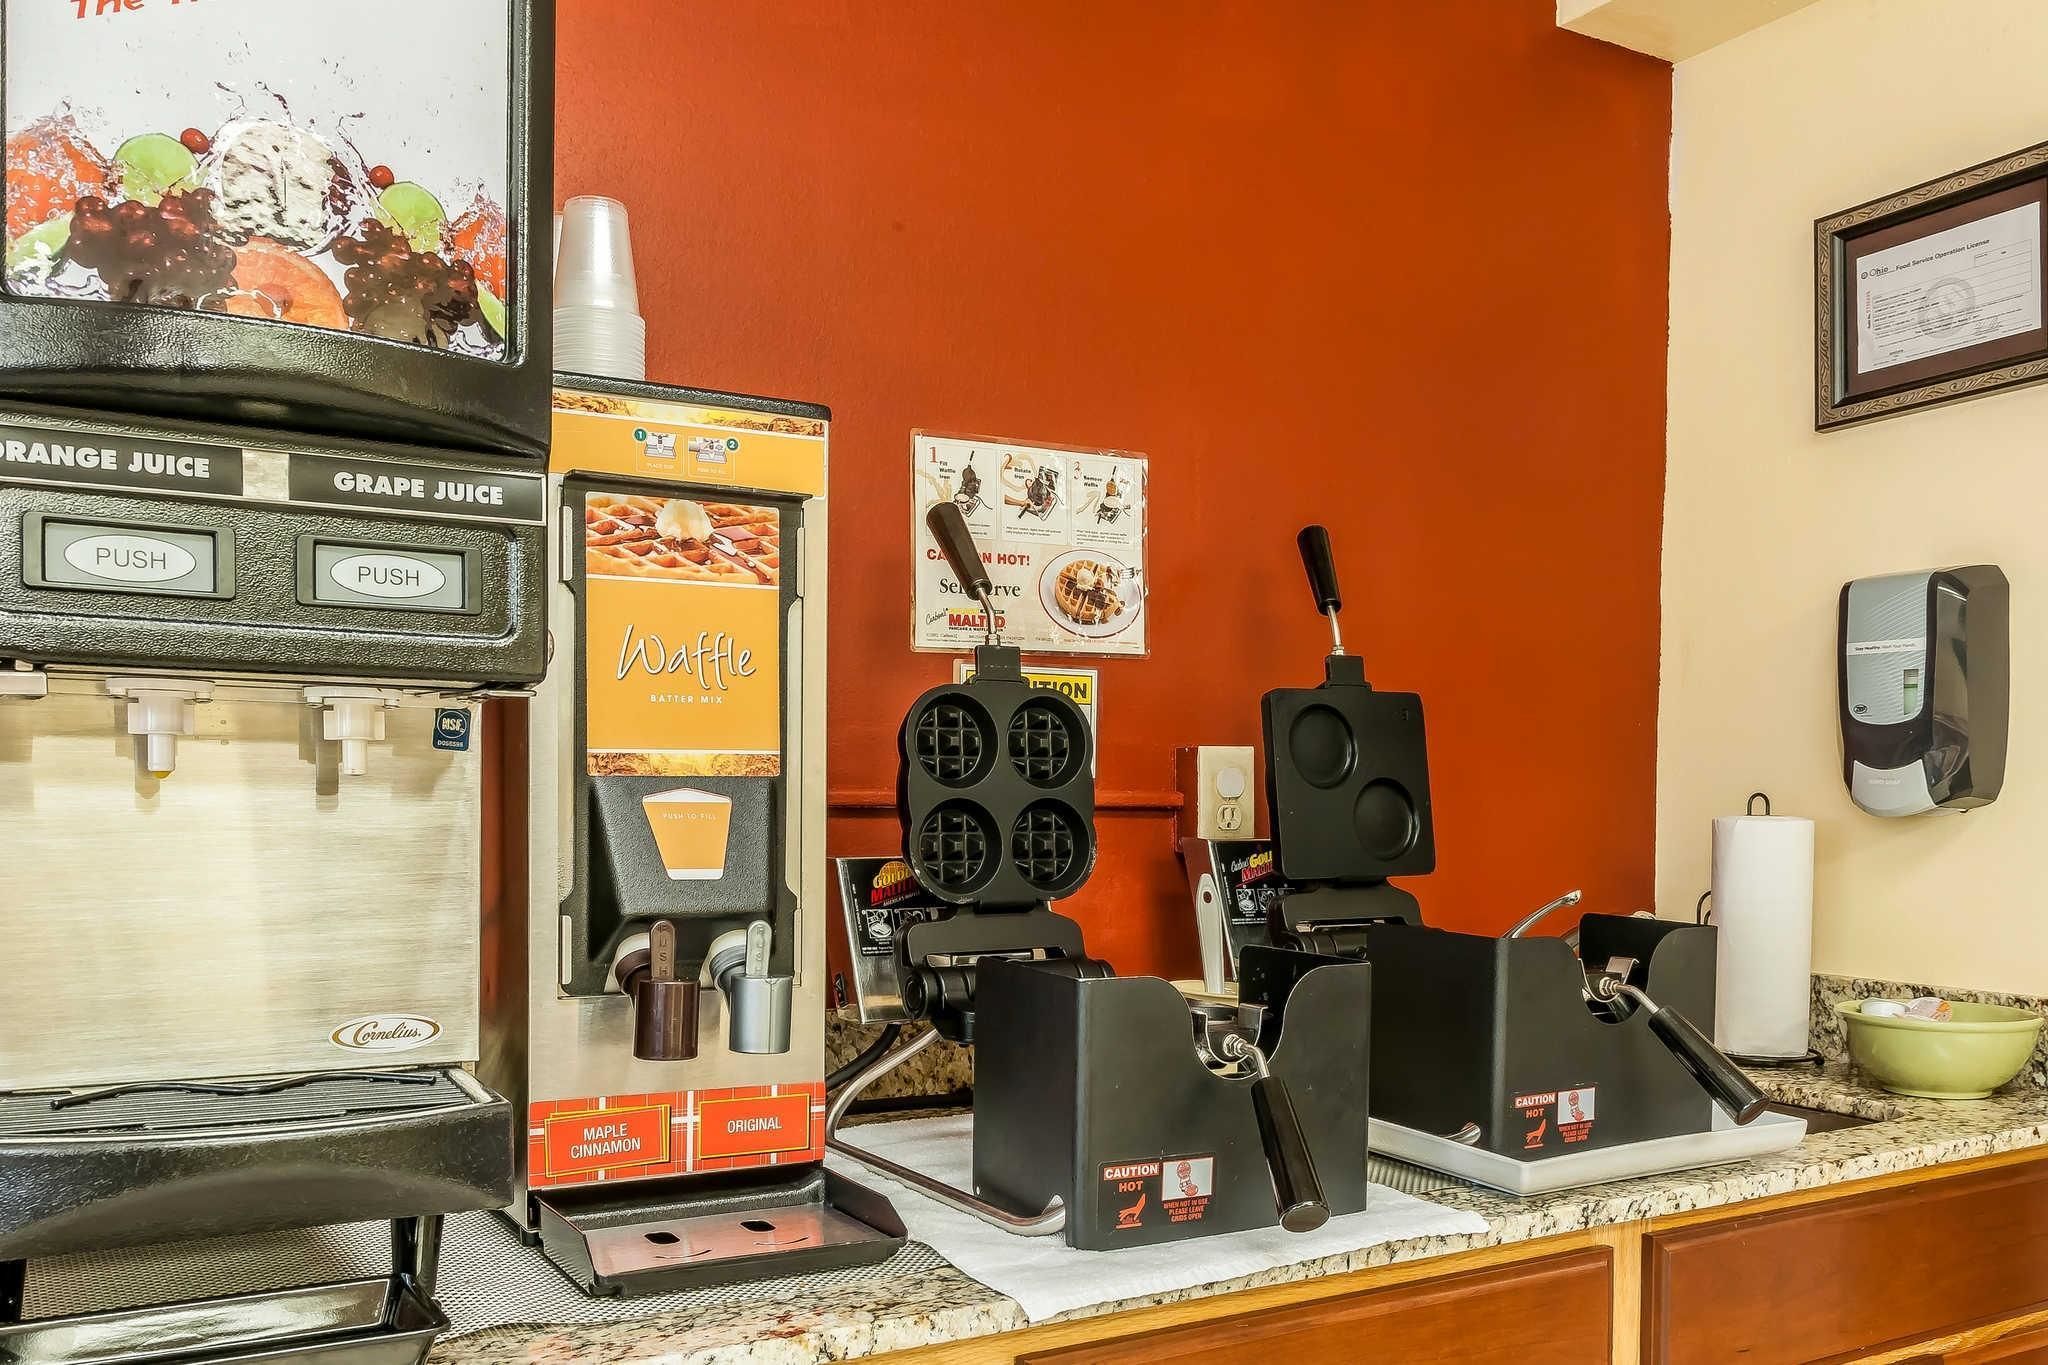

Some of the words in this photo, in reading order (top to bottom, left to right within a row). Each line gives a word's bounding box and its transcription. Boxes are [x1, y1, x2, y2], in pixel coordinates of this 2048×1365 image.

[1869, 266, 1889, 277] Ohio
[1895, 262, 1911, 271] Food
[1912, 255, 1934, 267] Service
[1934, 246, 1966, 259] Operation
[1966, 239, 1990, 250] License
[0, 440, 118, 471] RANGE
[128, 451, 210, 479] JUICE
[929, 446, 937, 463] 1
[1003, 453, 1013, 470] 2
[333, 471, 425, 498] GRAPE
[433, 481, 504, 506] JUICE
[96, 547, 167, 570] PUSH
[997, 553, 1030, 566] HOT!
[358, 566, 420, 587] PUSH
[948, 613, 1006, 628] MALTD
[616, 623, 757, 691] Waffle
[650, 694, 694, 704] BATTER
[700, 695, 723, 705] MIX
[663, 812, 684, 820] PUSH
[1515, 1093, 1556, 1107] CAUTION
[1526, 1108, 1544, 1119] HOT
[583, 1122, 628, 1142] MAPLE
[727, 1116, 782, 1134] ORIGINAL
[570, 1137, 641, 1159] CINNAMON
[1105, 1164, 1159, 1179] CAUTION
[1119, 1180, 1144, 1193] HOT
